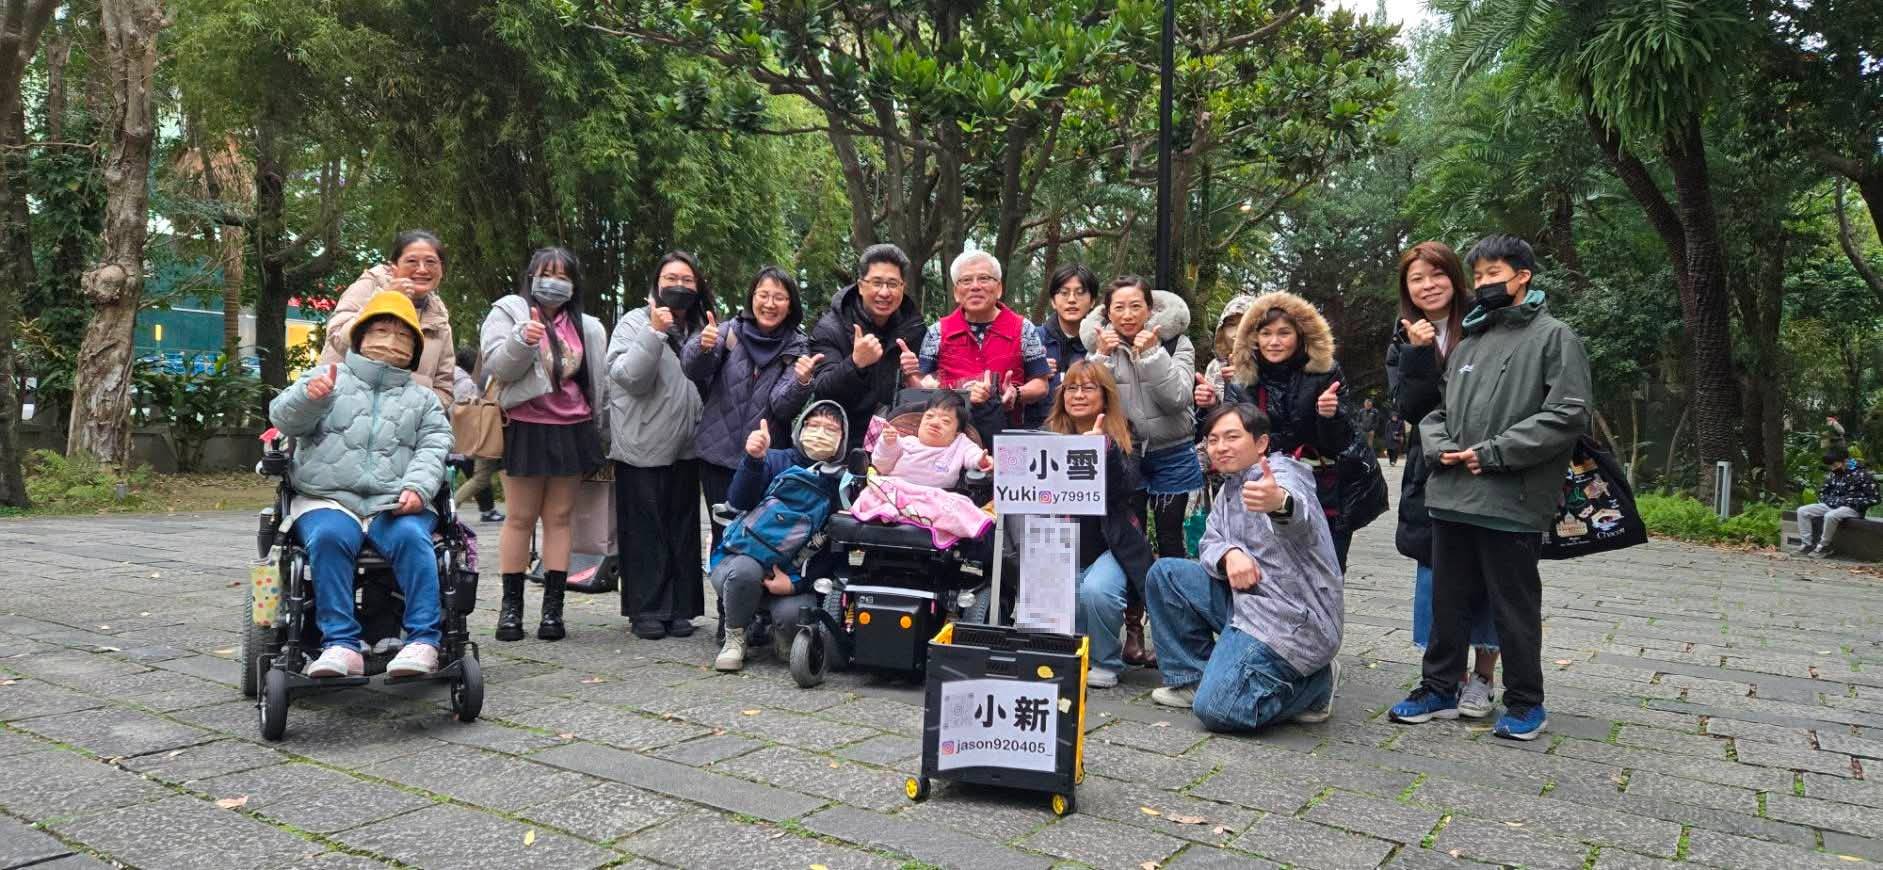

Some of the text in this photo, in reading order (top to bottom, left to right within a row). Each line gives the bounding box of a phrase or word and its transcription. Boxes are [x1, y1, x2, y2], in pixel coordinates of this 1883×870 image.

[1029, 449, 1098, 480] 小雪
[997, 486, 1100, 504] Yuki y79915
[974, 694, 1050, 733] 小新
